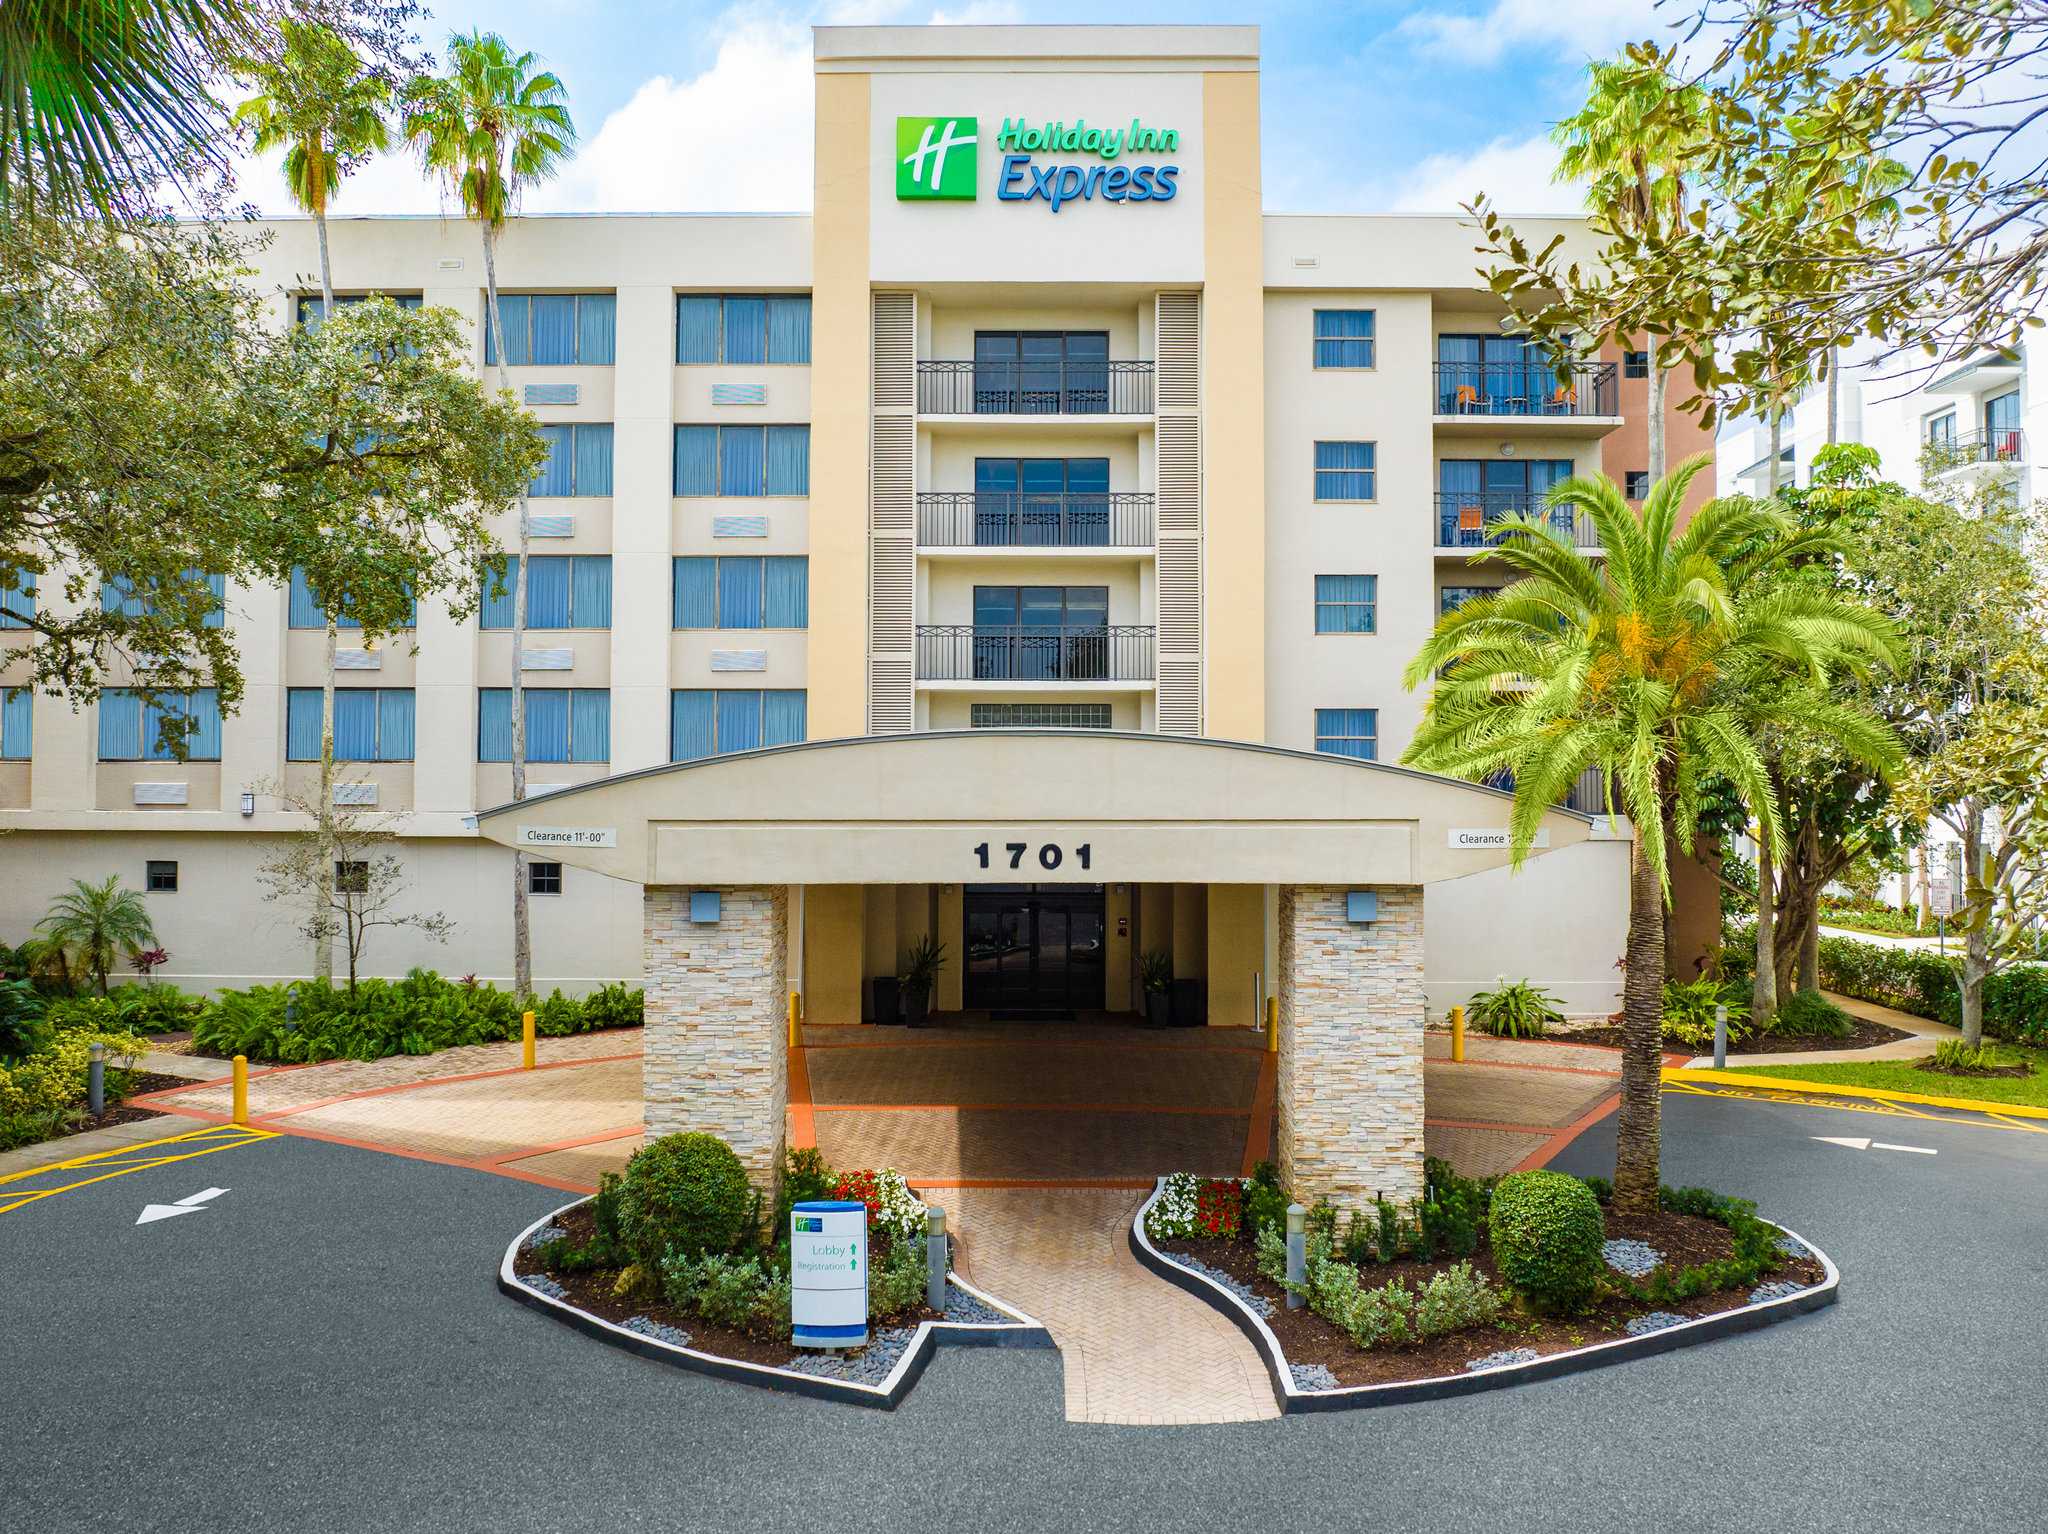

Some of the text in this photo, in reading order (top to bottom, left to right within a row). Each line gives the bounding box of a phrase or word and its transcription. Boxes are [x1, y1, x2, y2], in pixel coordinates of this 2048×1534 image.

[997, 117, 1179, 159] Holiday Inn
[997, 154, 1179, 213] Express
[527, 830, 573, 842] Clearance
[1459, 833, 1505, 844] Clearance
[974, 842, 1091, 870] 1701
[812, 1245, 846, 1258] Lobby
[798, 1261, 846, 1272] Registration
